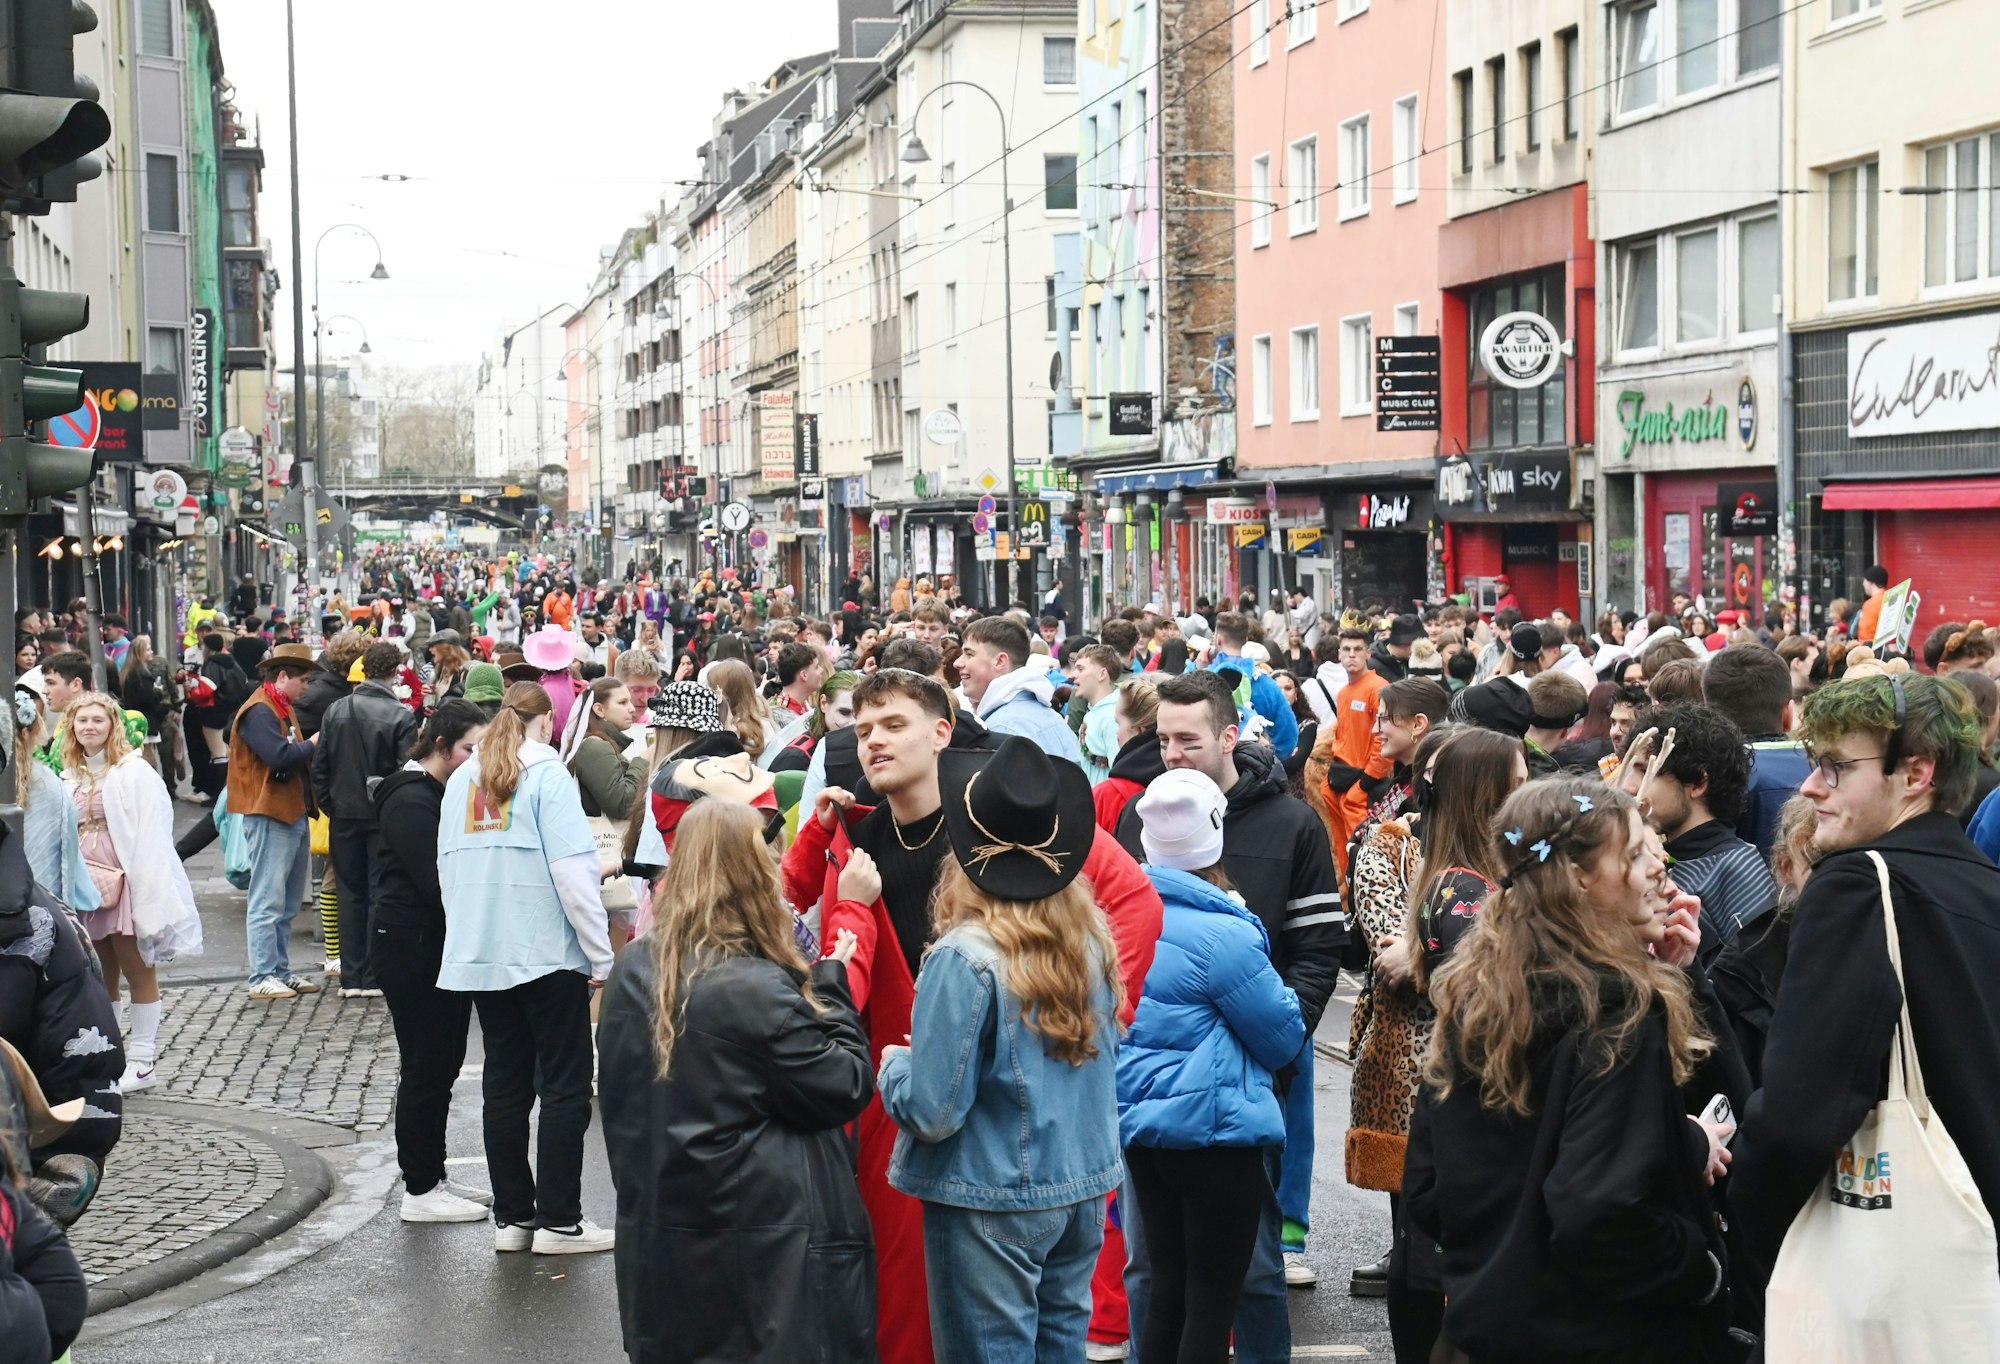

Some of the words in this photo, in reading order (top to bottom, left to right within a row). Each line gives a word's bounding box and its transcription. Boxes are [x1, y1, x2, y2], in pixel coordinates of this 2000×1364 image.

[1380, 339, 1393, 351] M
[1492, 345, 1554, 354] KWARTIER
[1381, 358, 1392, 370] T
[1381, 378, 1392, 390] C
[763, 393, 792, 405] Falafel
[1381, 400, 1410, 408] MUSIC
[1411, 399, 1436, 408] CLUB
[1120, 404, 1142, 414] Gaffel
[1616, 386, 1728, 458] Fant-asia
[102, 426, 127, 437] bar
[765, 450, 792, 460] ברכה
[1522, 465, 1562, 490] sky
[1242, 528, 1262, 536] CASH
[1296, 532, 1318, 540] CASH
[473, 823, 503, 832] KOLINSKI
